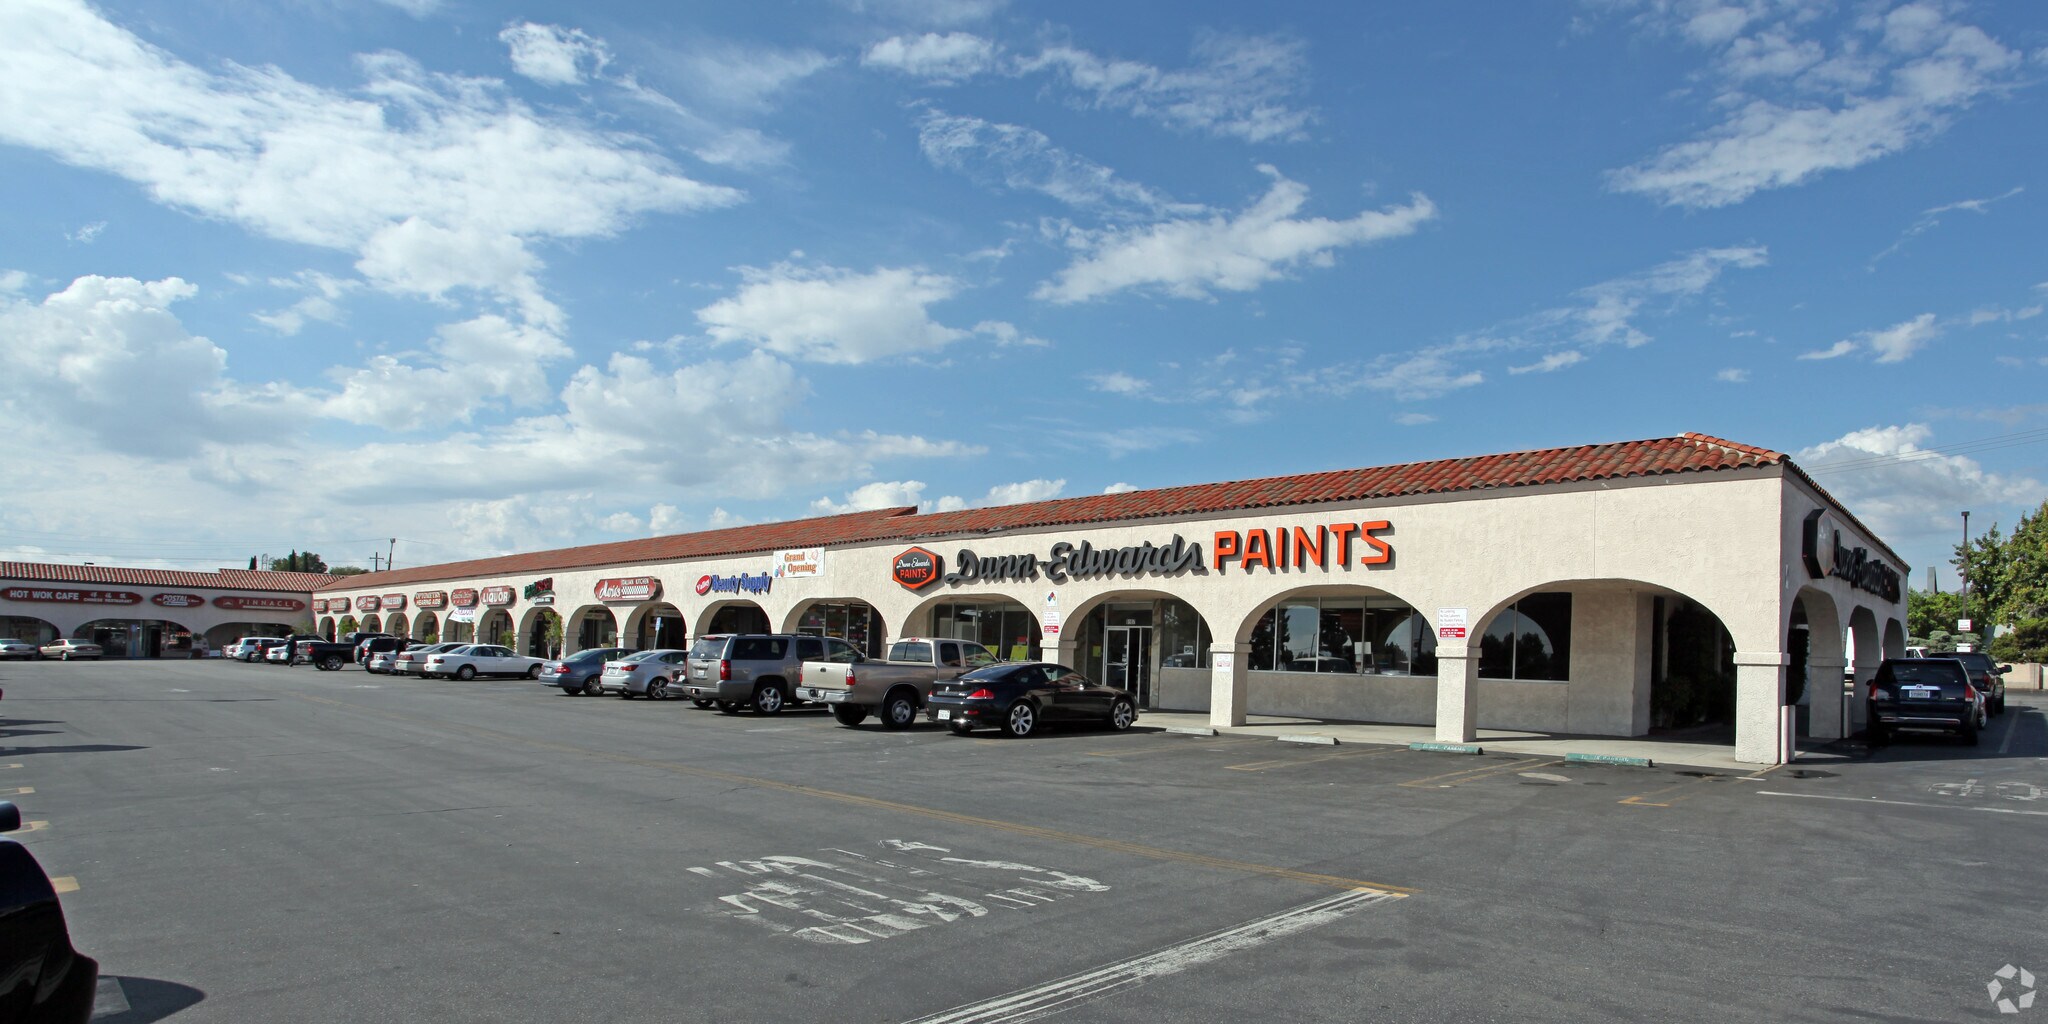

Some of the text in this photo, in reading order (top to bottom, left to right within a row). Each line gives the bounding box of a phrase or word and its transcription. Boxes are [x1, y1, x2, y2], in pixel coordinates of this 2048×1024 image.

[785, 552, 805, 562] Grand
[945, 520, 1389, 583] Dunn-Edwards PAINTS
[788, 562, 817, 574] Opening
[900, 568, 927, 578] PAINTS
[741, 573, 770, 593] Supply
[10, 590, 80, 600] HOT WOK CAFE
[483, 591, 511, 603] LIQUOR
[239, 599, 297, 607] PINNACLE
